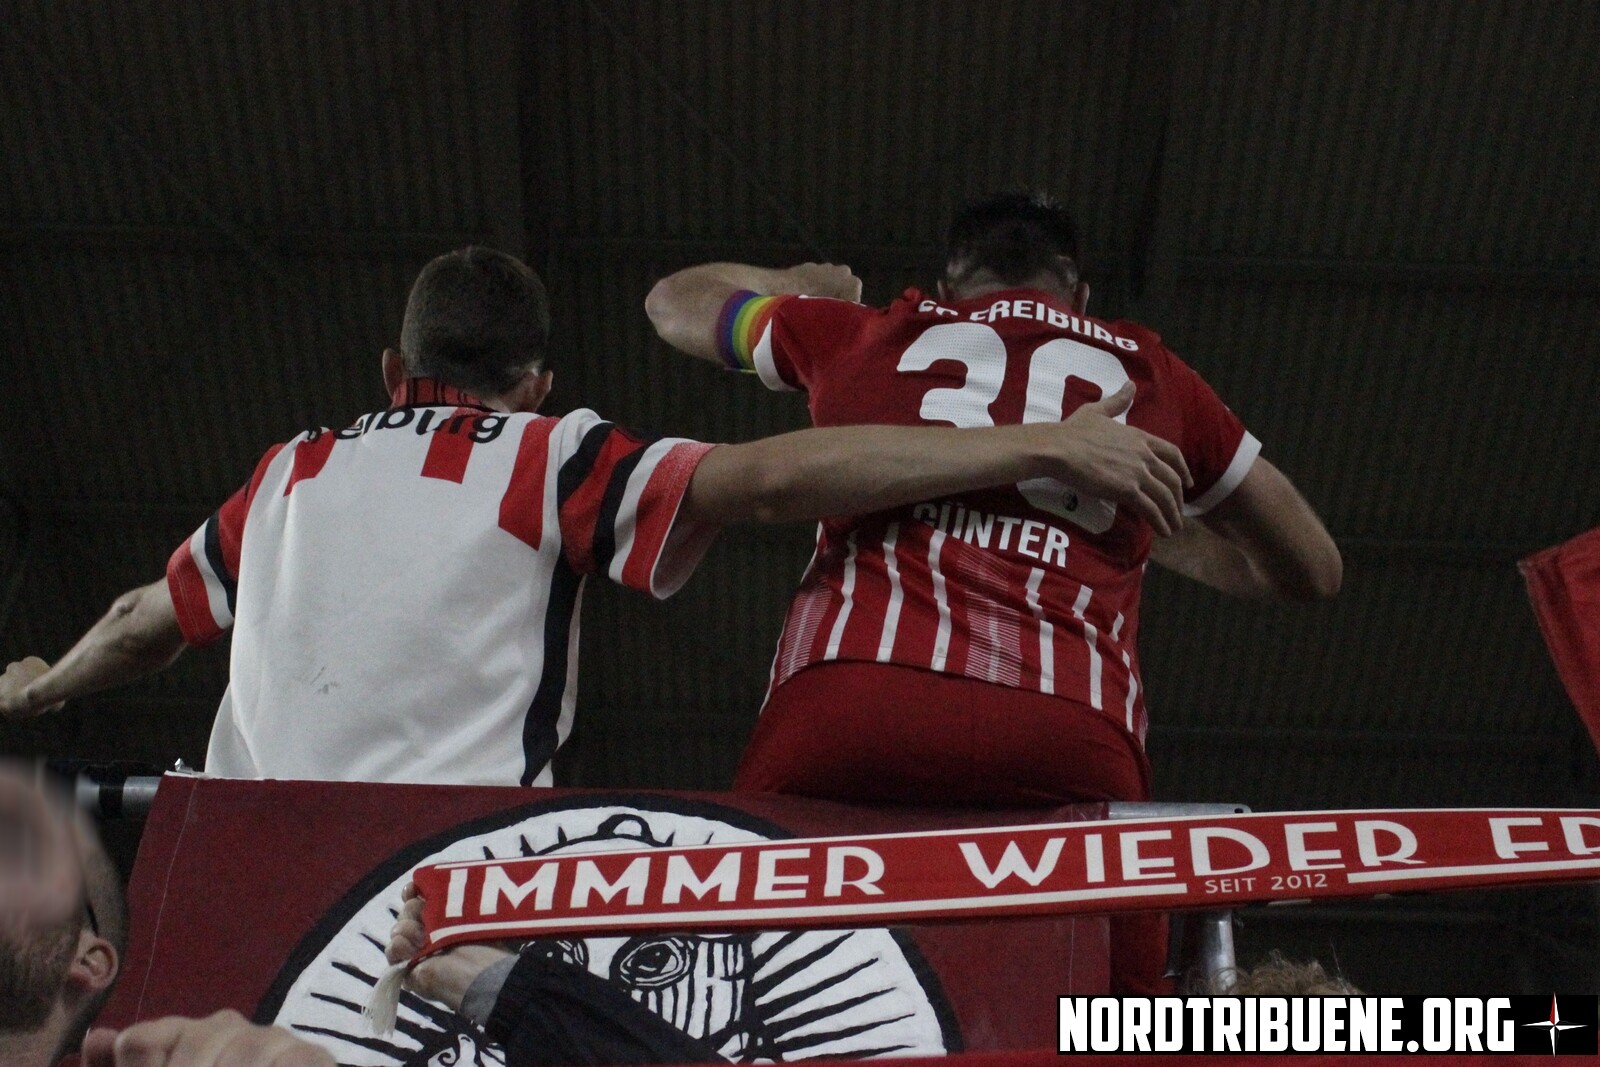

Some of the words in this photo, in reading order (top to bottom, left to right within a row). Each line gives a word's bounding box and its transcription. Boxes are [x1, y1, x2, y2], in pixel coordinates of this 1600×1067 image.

[913, 503, 1070, 559] GÜNTER
[445, 846, 886, 918] IMMMER
[958, 819, 1427, 889] WIEDER
[1204, 877, 1257, 894] SEIT
[1270, 873, 1328, 891] 2012
